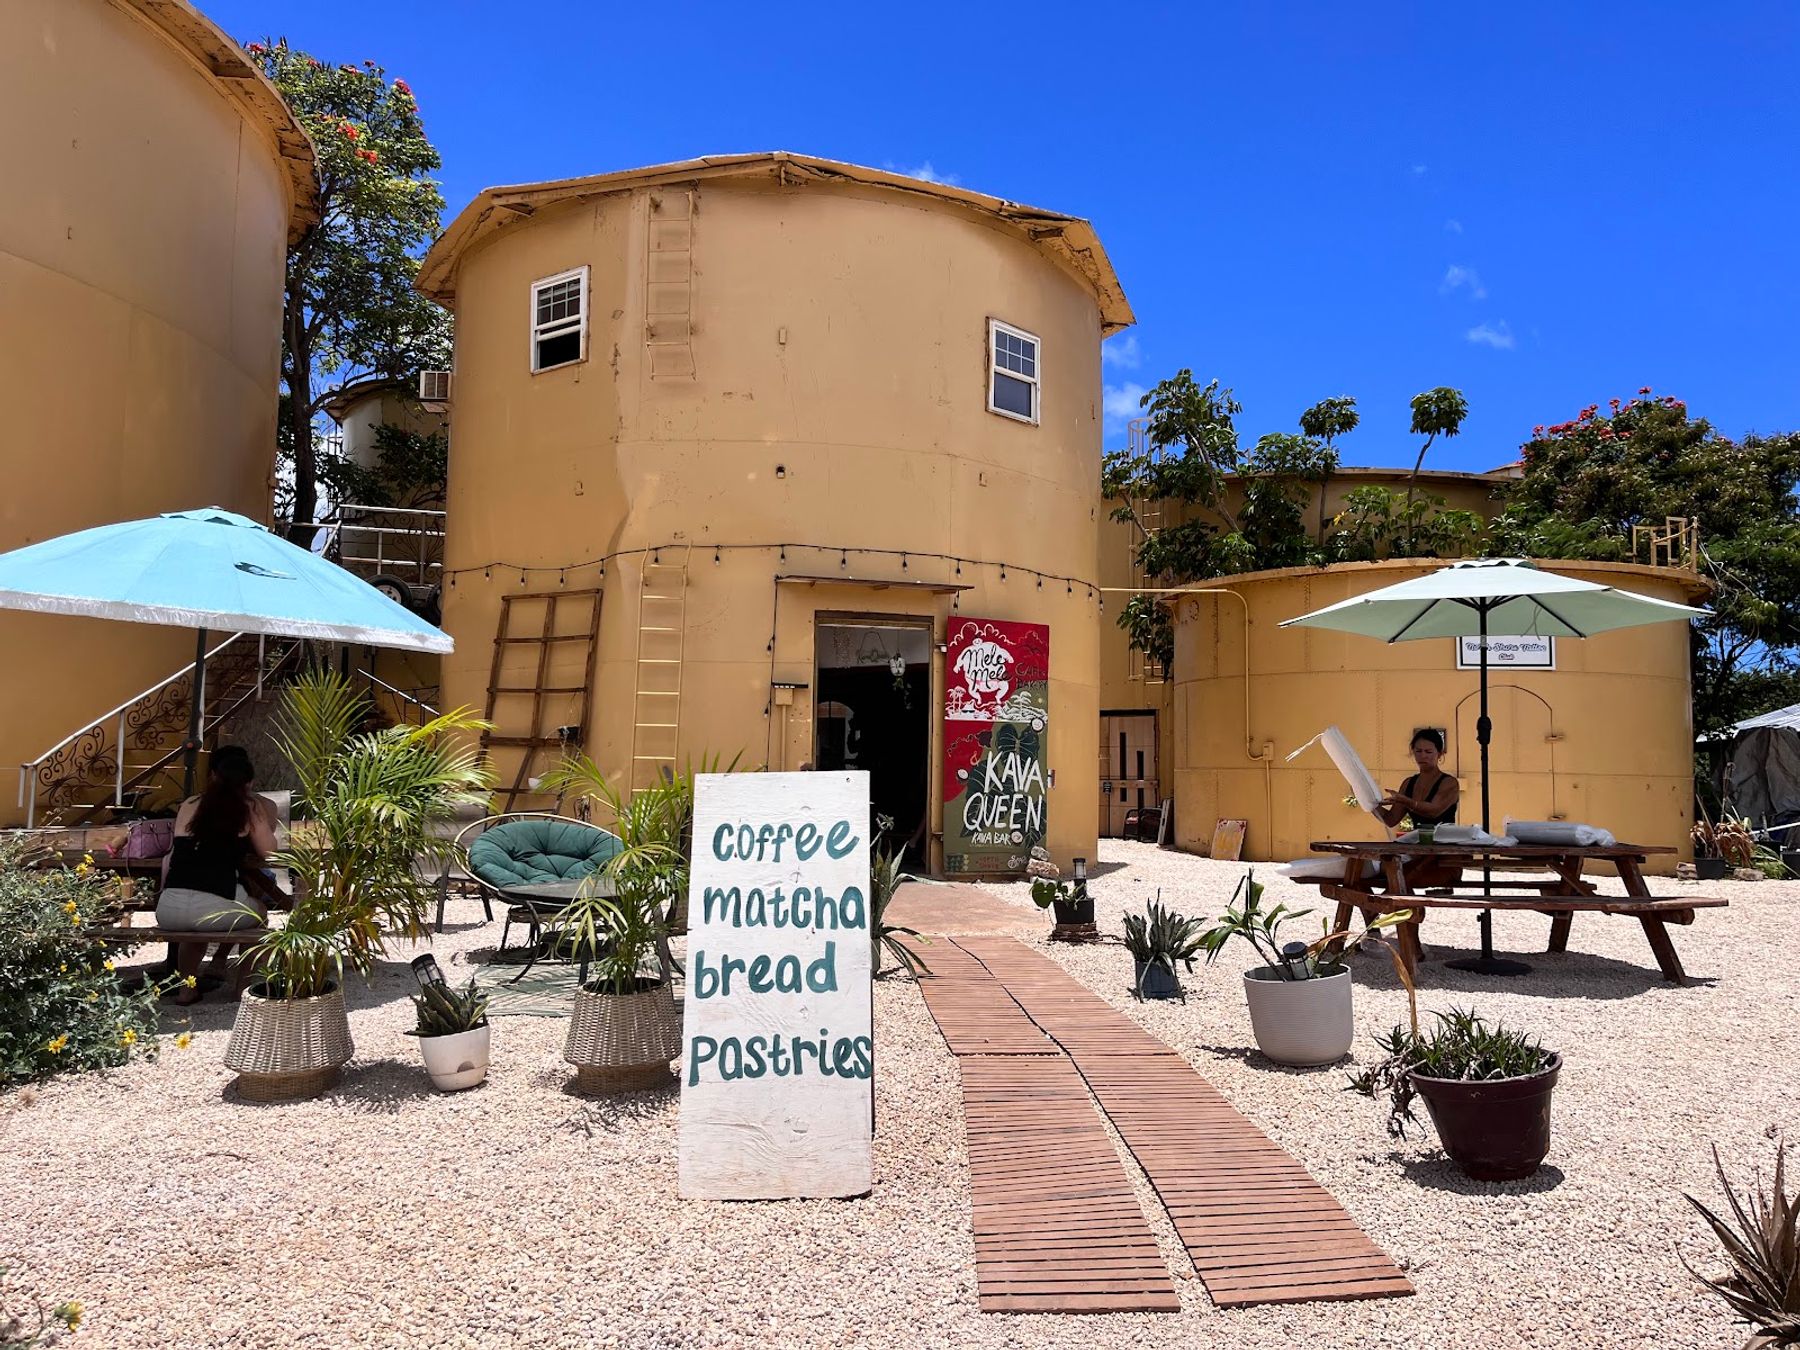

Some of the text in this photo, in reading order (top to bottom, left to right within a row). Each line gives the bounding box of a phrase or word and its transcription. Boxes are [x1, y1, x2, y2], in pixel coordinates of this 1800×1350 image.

[962, 644, 1006, 674] Mele
[968, 665, 1013, 690] Mele
[984, 750, 1045, 794] KAVA
[963, 792, 1042, 832] QUEEN
[712, 820, 861, 863] coffee
[971, 831, 1012, 846] KAVA BAR
[703, 886, 867, 930] matcha
[694, 940, 838, 999] bread
